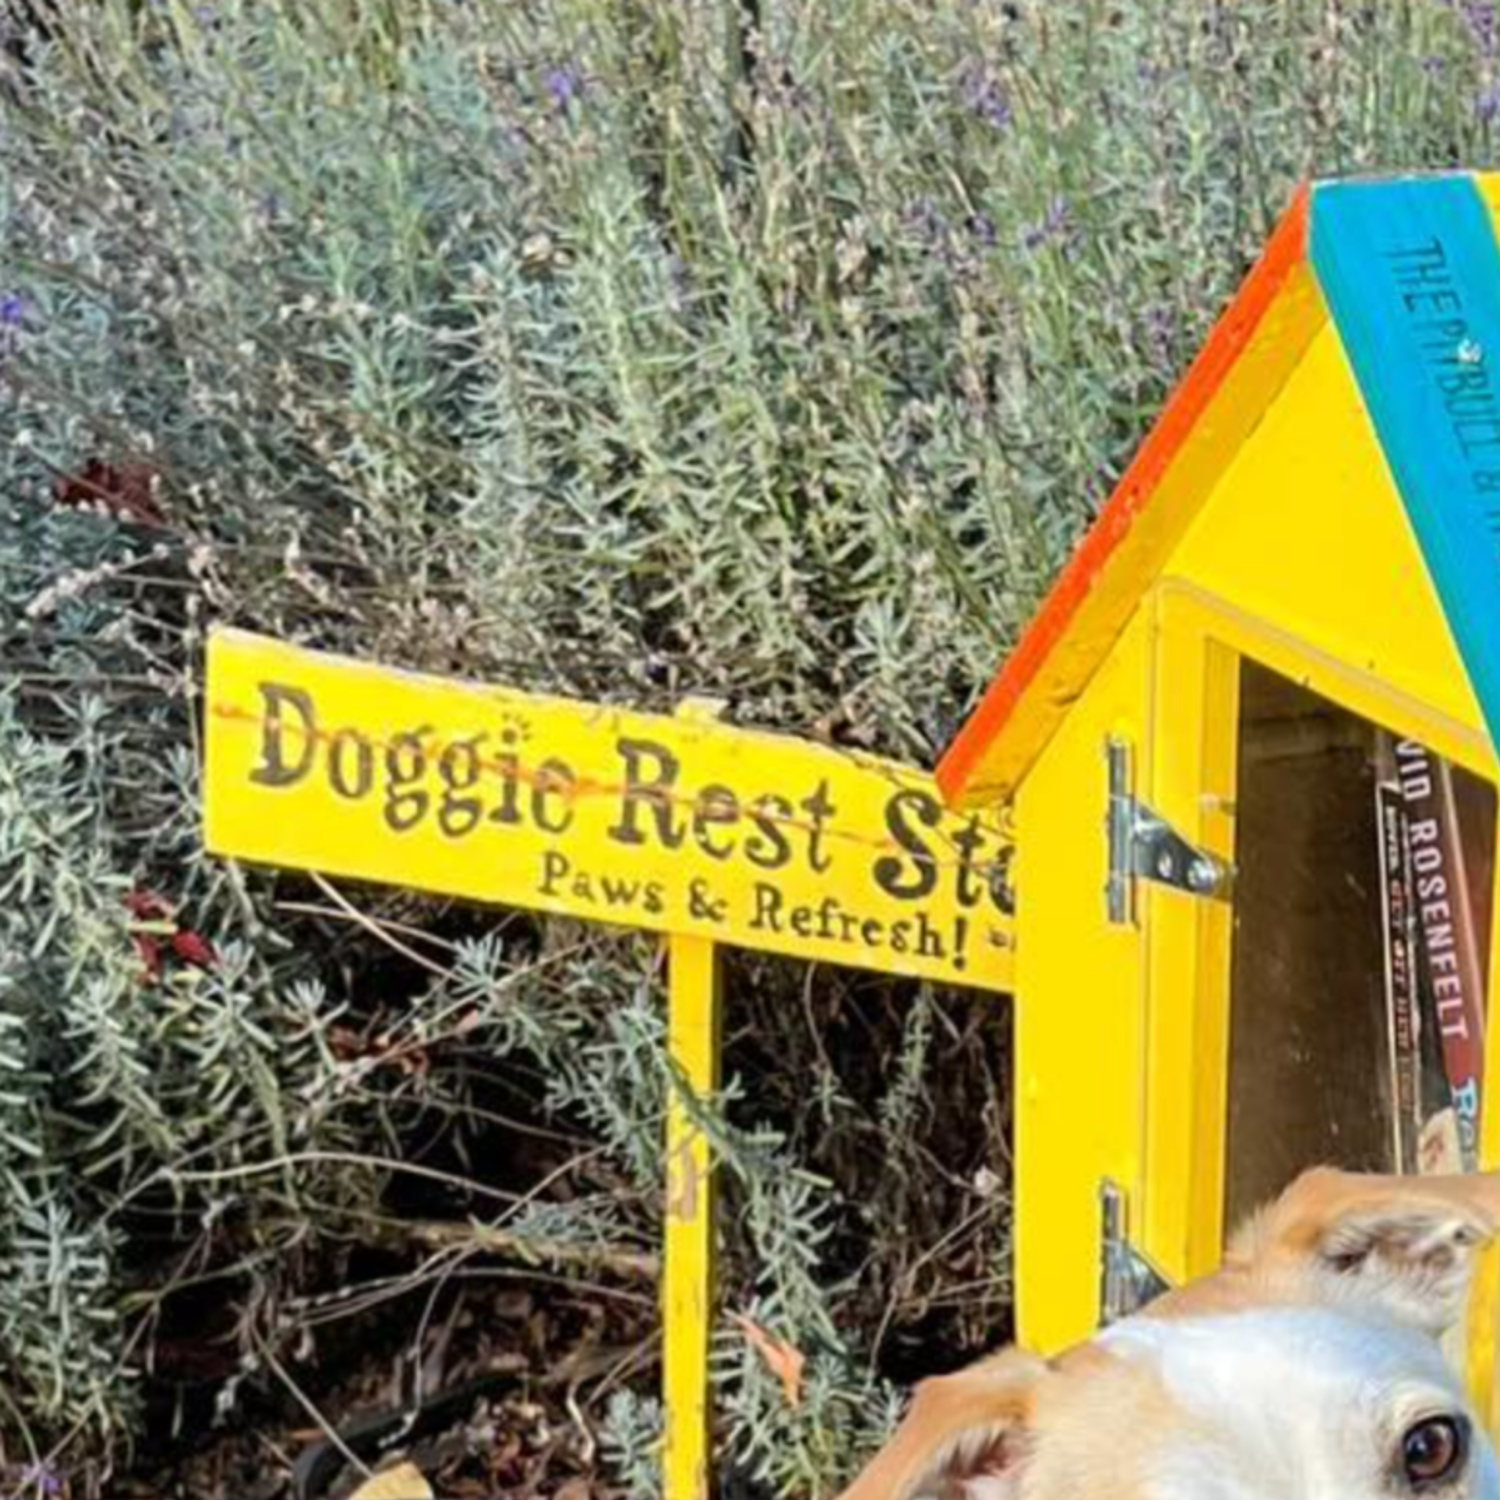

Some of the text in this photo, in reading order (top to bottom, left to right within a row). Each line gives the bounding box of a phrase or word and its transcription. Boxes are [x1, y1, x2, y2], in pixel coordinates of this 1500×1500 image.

[1383, 239, 1465, 313] THE
[248, 681, 577, 838] Doggie
[608, 737, 836, 874] Rest
[538, 852, 967, 971] Paws & Refresh!
[1410, 818, 1469, 1039] ROSENFELT
